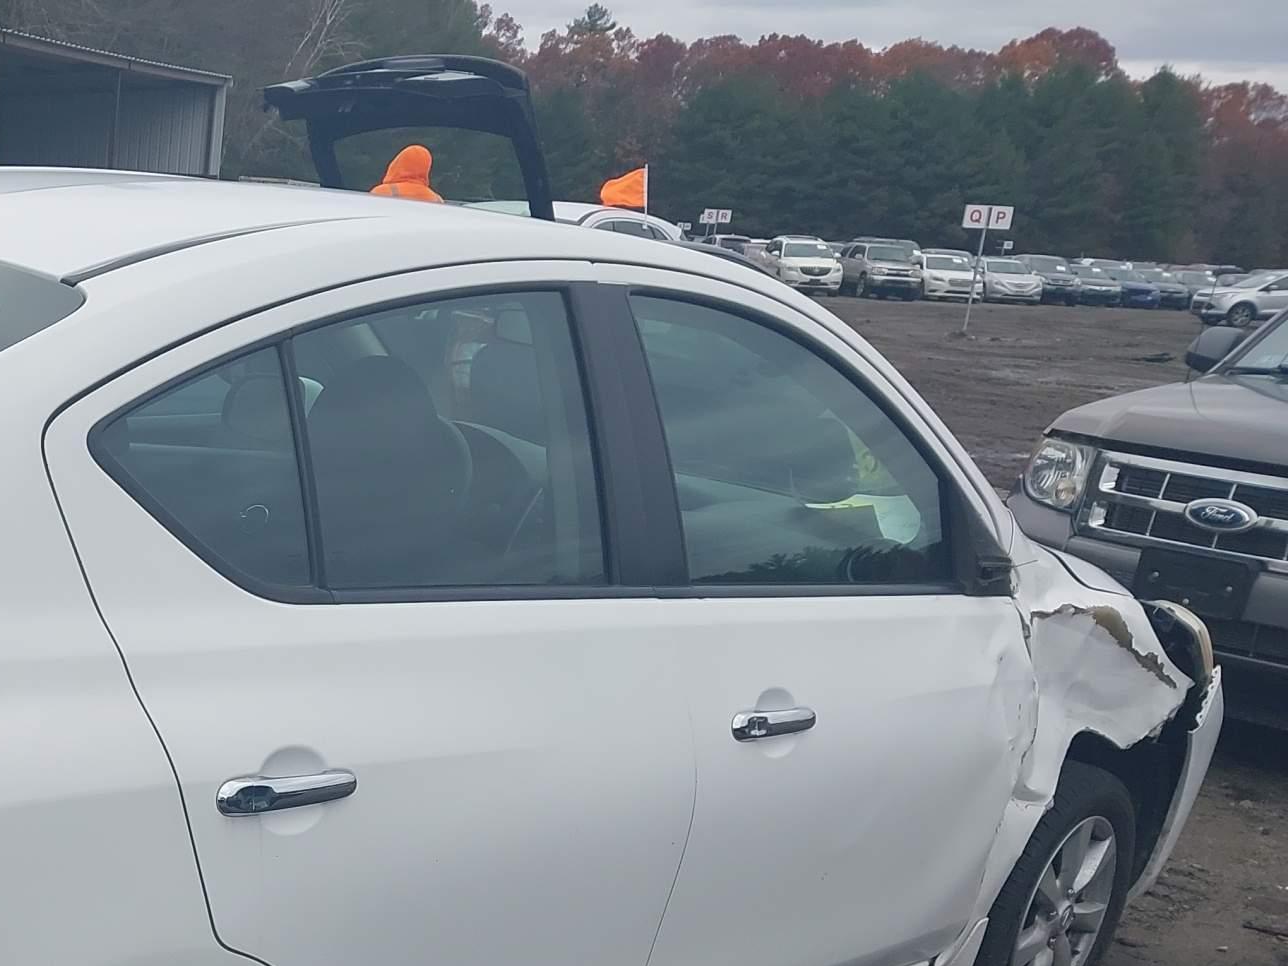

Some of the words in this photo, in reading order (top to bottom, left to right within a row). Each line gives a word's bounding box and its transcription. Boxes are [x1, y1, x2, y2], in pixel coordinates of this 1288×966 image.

[707, 211, 714, 219] S
[721, 212, 728, 220] R
[970, 209, 982, 224] Q
[996, 211, 1006, 224] P
[1201, 506, 1235, 521] Ford
